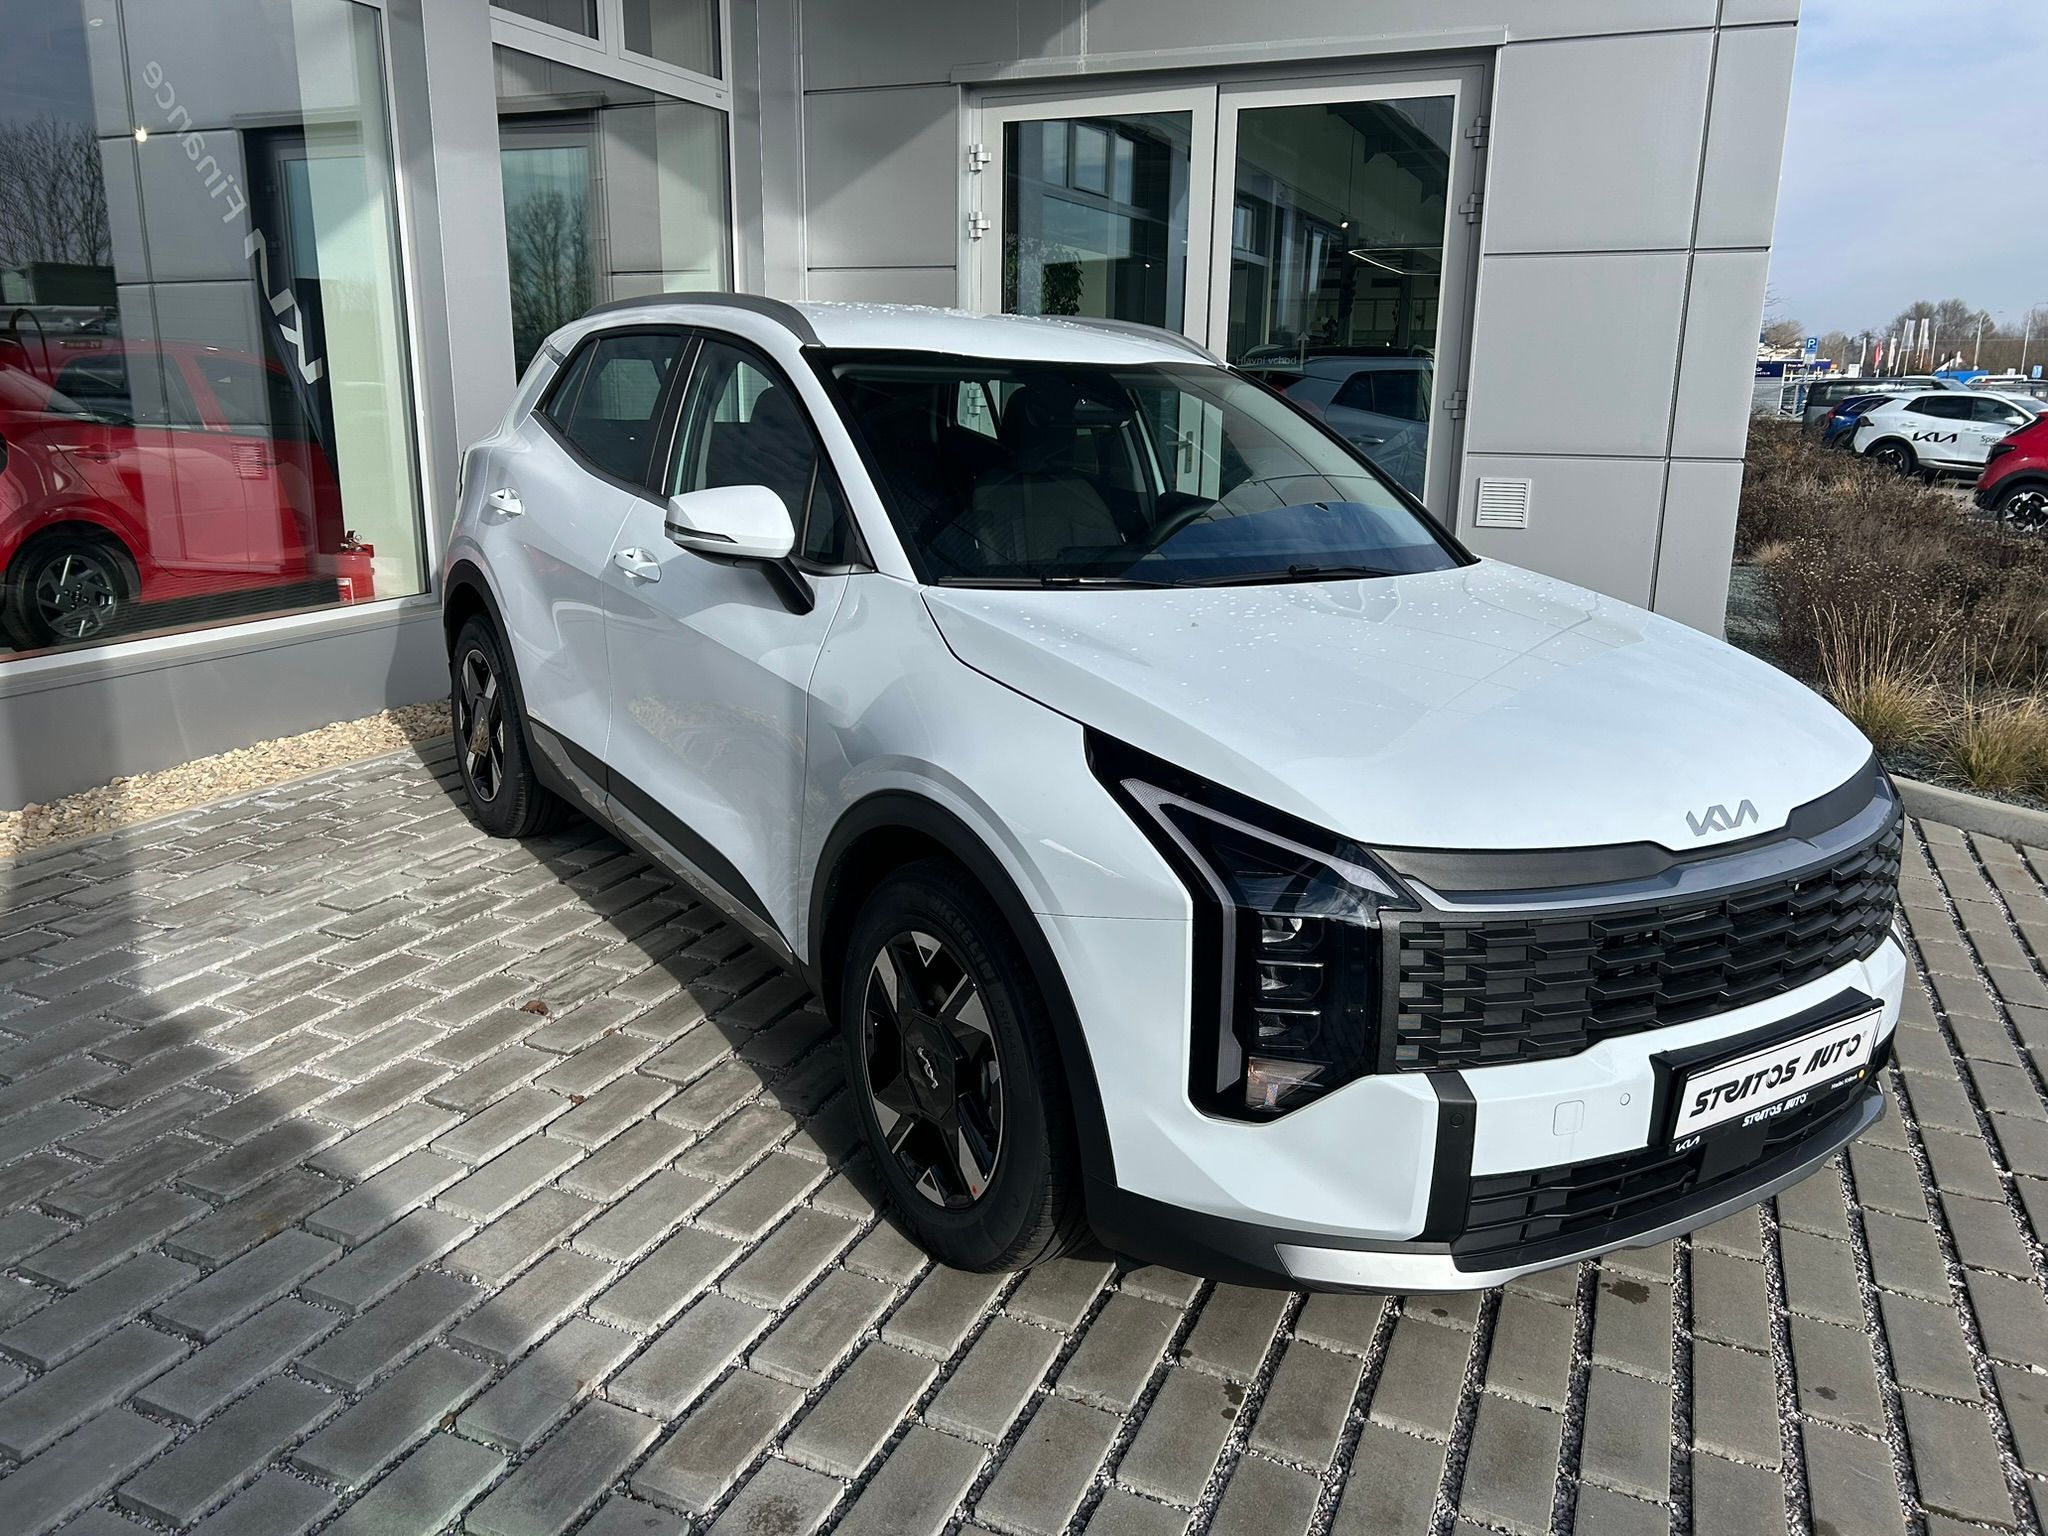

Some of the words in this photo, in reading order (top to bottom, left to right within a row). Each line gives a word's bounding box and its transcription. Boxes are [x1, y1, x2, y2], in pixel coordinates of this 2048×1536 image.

[1808, 338, 1816, 349] P
[1268, 355, 1297, 365] vchod
[1912, 431, 1958, 443] KIA
[1686, 799, 1760, 837] KIA
[1689, 1056, 1802, 1118] STRATOS
[1803, 1033, 1862, 1075] AUTO
[1741, 1102, 1783, 1128] STRATOS
[1783, 1094, 1807, 1113] AUTO
[1675, 1135, 1701, 1153] KIA
